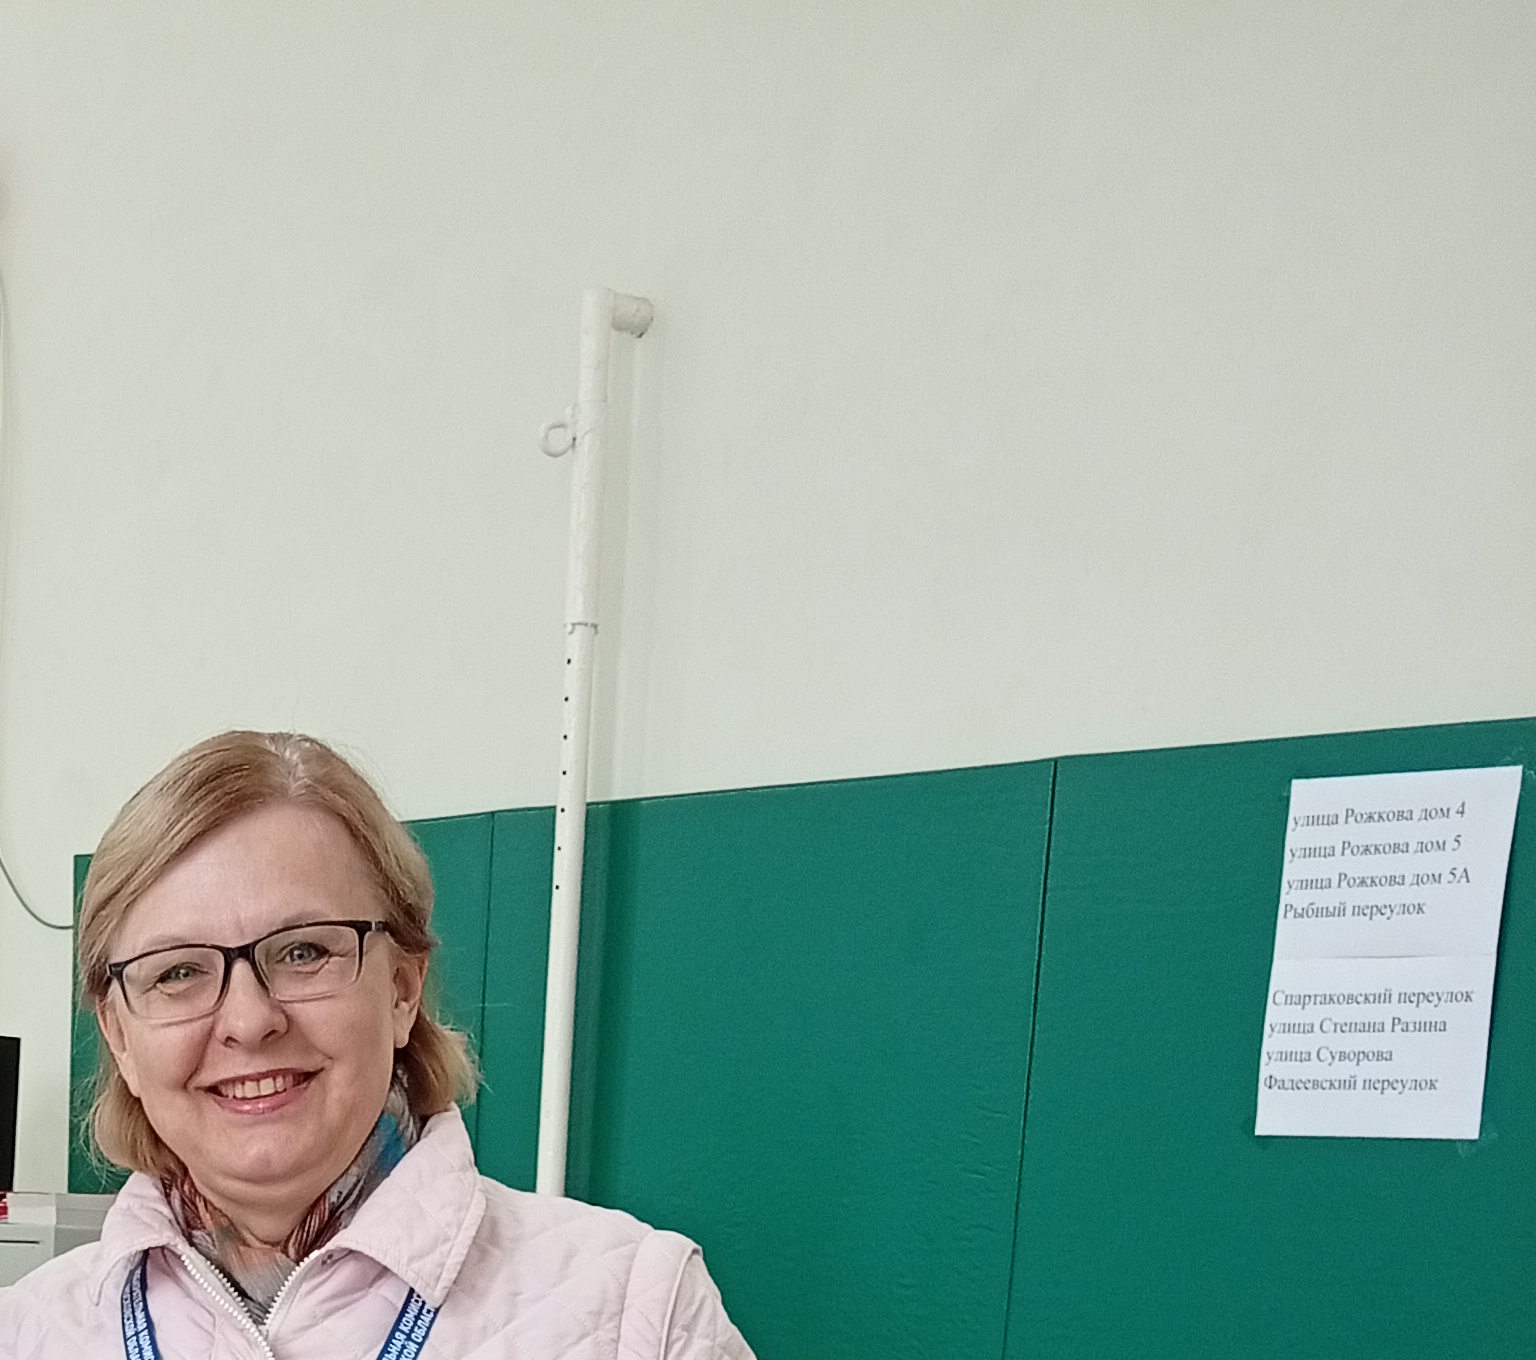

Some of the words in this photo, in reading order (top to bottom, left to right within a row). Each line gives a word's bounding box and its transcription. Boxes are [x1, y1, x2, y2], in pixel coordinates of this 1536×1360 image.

[1292, 812, 1339, 832] улица
[1344, 806, 1414, 826] Рожкова
[1417, 807, 1450, 823] дом
[1455, 802, 1466, 818] 4
[1289, 842, 1336, 863] улица
[1340, 838, 1410, 858] Рожкова
[1414, 838, 1447, 855] дом
[1451, 834, 1462, 852] 5
[1285, 875, 1332, 894] улица
[1336, 871, 1406, 890] Рожкова
[1410, 872, 1443, 888] дом
[1283, 901, 1347, 920] Рыбный
[1351, 901, 1426, 921] переулок
[1272, 987, 1393, 1012] Спартаковский
[1397, 989, 1474, 1009] переулок
[1268, 1019, 1315, 1039] улица
[1319, 1017, 1386, 1035] Степана
[1390, 1016, 1447, 1034] Разина
[1265, 1049, 1312, 1068] улица
[1316, 1046, 1393, 1066] Суворова
[1263, 1074, 1357, 1093] Фадеевский
[1362, 1076, 1438, 1095] переулок
